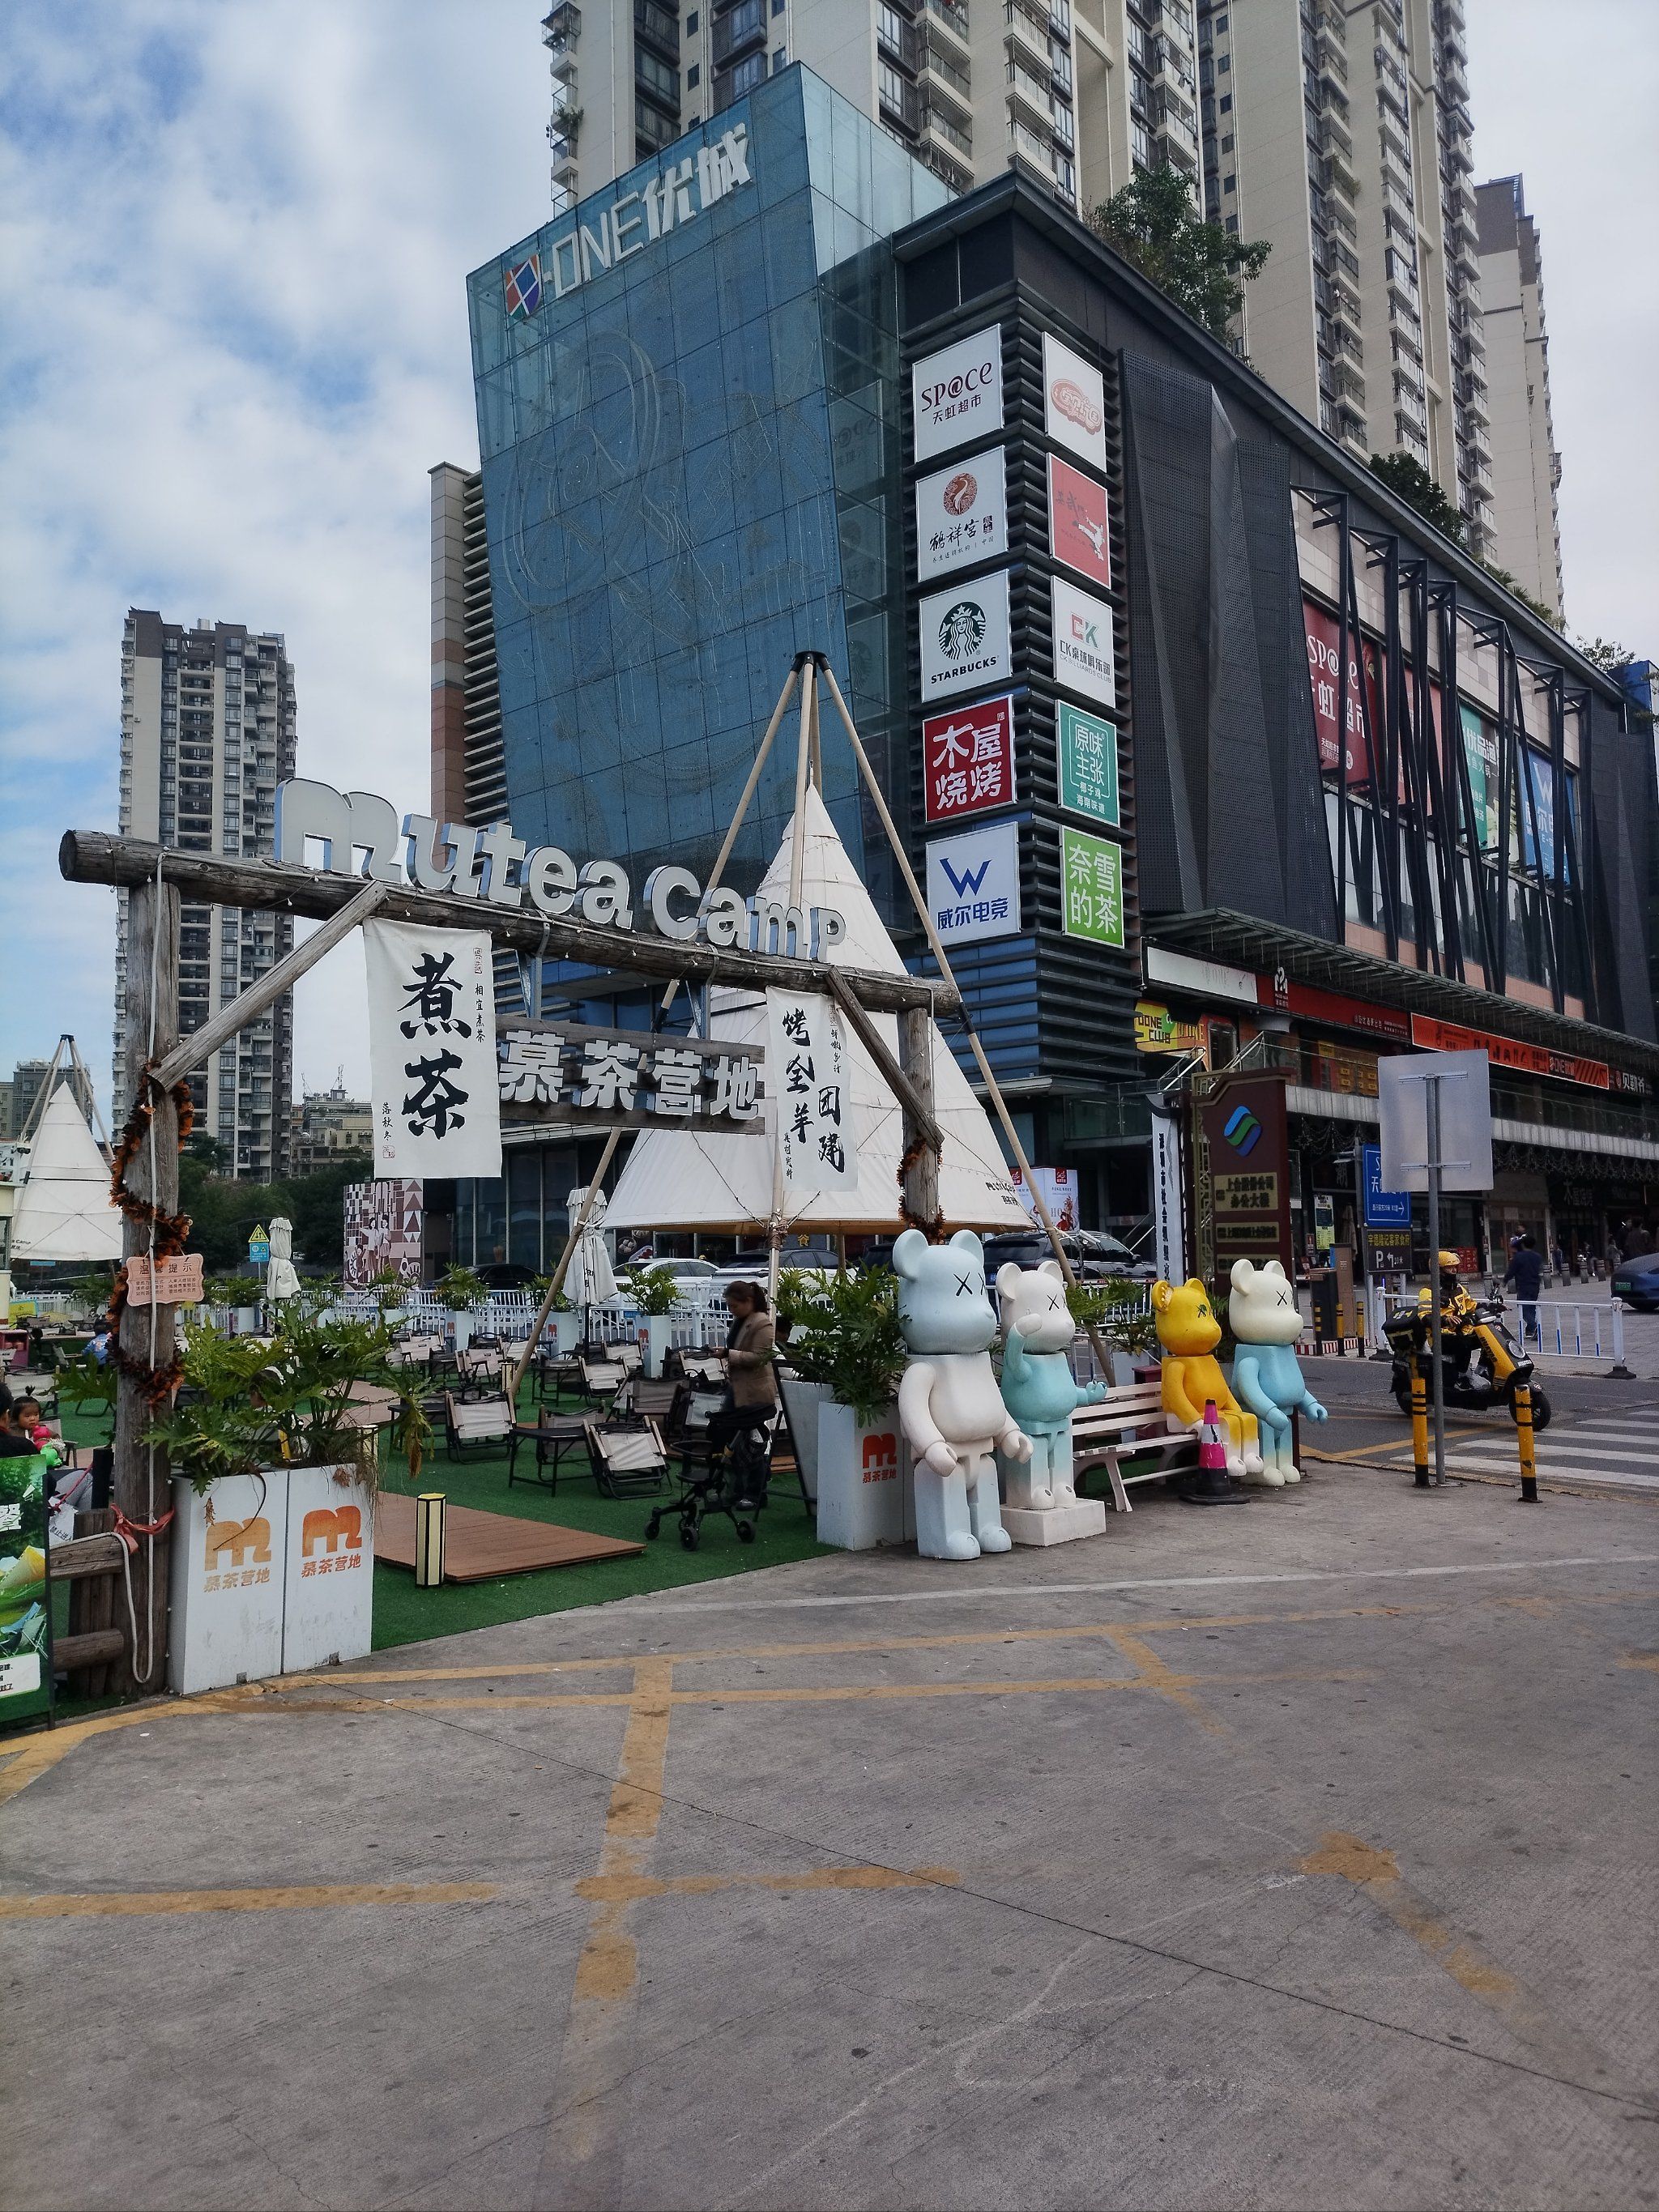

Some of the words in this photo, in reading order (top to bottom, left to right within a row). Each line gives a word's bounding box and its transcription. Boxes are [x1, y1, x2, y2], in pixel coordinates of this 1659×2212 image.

[932, 396, 982, 425] 天虹超市
[931, 657, 997, 684] STARBUCKS
[932, 722, 1002, 769] 木屋
[1074, 723, 1103, 760] 原味
[935, 761, 1002, 810] 烧烤
[1076, 756, 1105, 787] 主张
[940, 857, 992, 899] W
[1068, 843, 1116, 893] 奈雪
[937, 897, 1009, 930] 威尔电竞
[1070, 885, 1119, 934] 的茶
[475, 983, 486, 1043] 相宜煮茶
[396, 952, 472, 1140] 煮茶
[499, 1029, 760, 1119] 慕茶营地
[783, 1008, 816, 1144] 烤全羊
[818, 1085, 845, 1174] 团建
[1376, 1251, 1384, 1268] P
[203, 1567, 271, 1592] 慕茶营地
[301, 1554, 361, 1578] 慕茶营地
